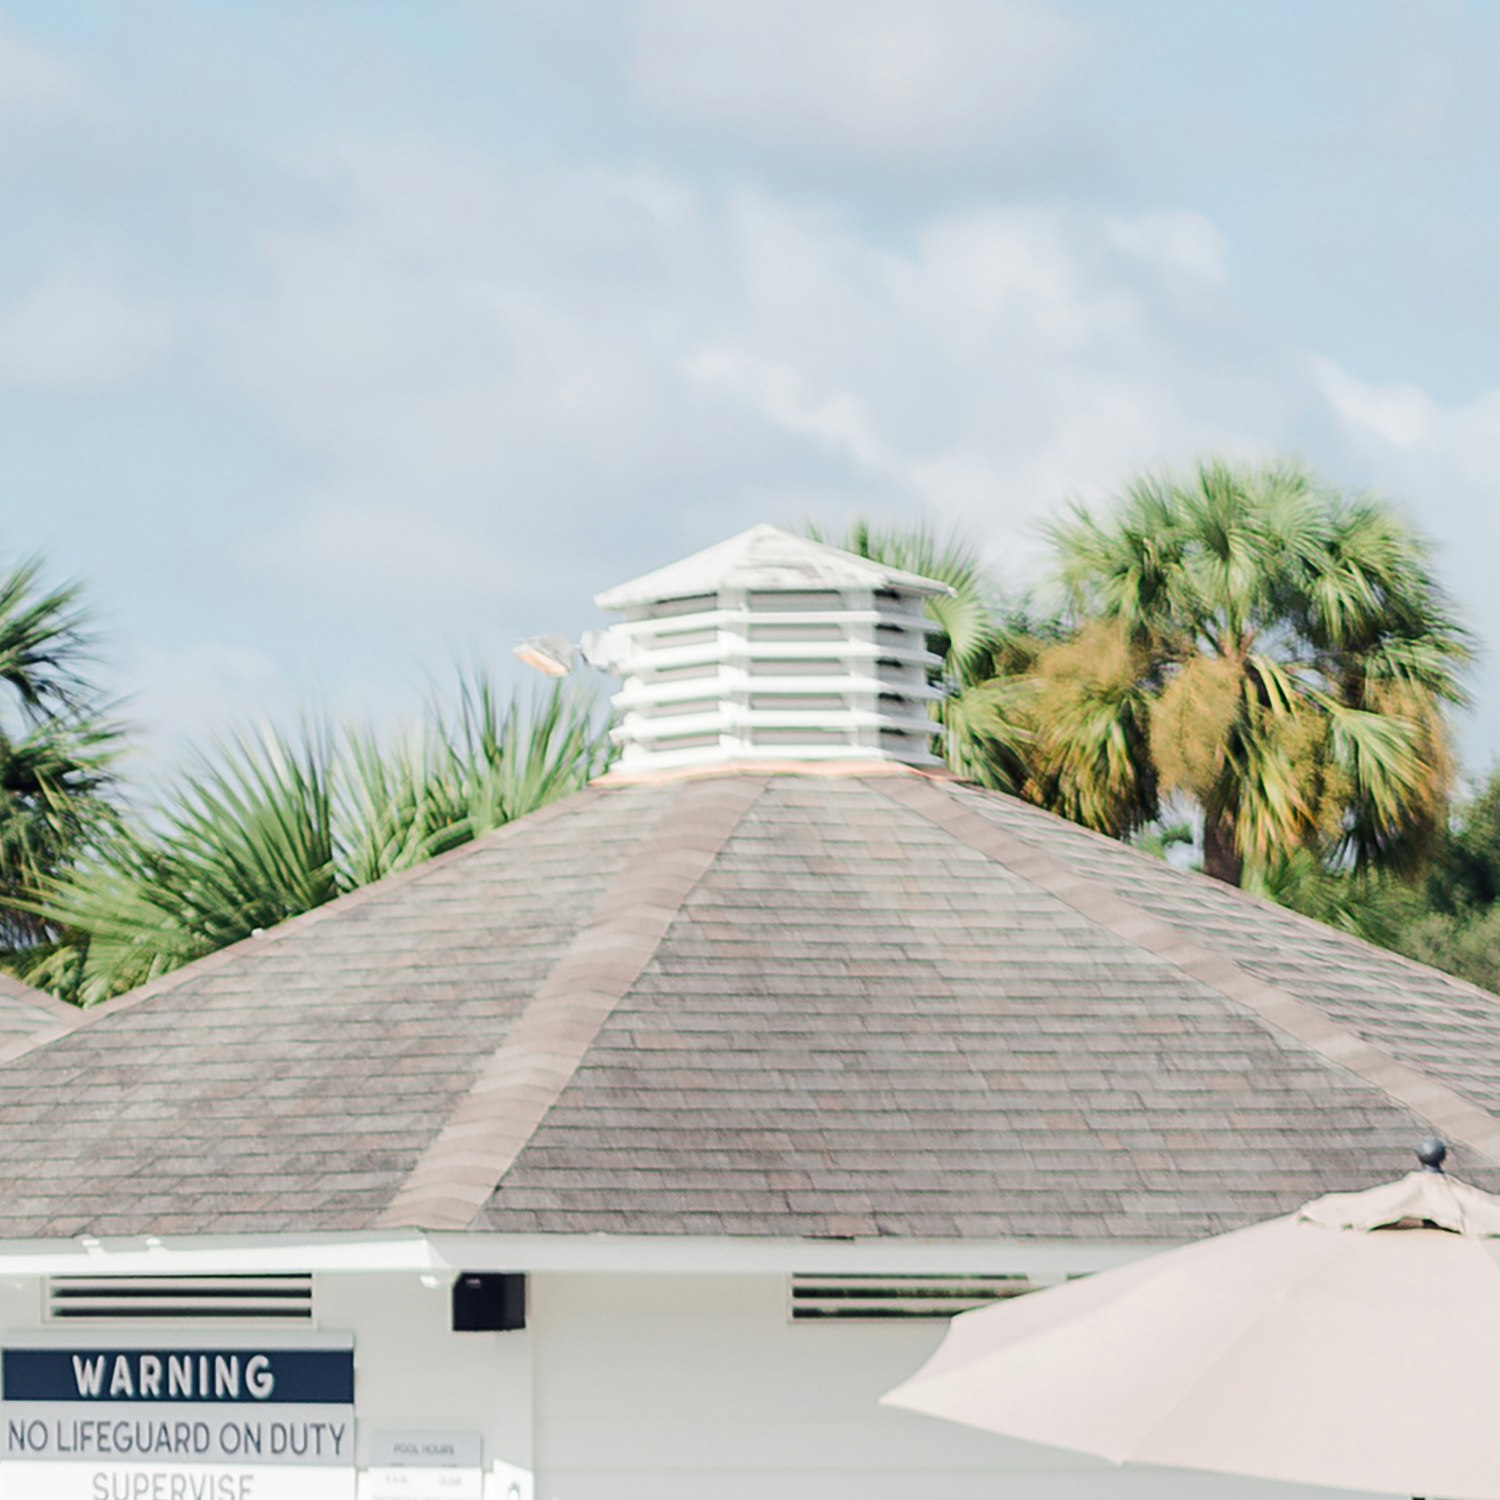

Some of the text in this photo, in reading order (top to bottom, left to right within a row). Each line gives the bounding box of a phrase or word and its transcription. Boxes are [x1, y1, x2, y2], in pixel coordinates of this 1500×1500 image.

[72, 1355, 276, 1399] WARNING
[8, 1420, 346, 1457] NO LIFEGUARD ON DUTY
[393, 1442, 455, 1456] POOL HOURS
